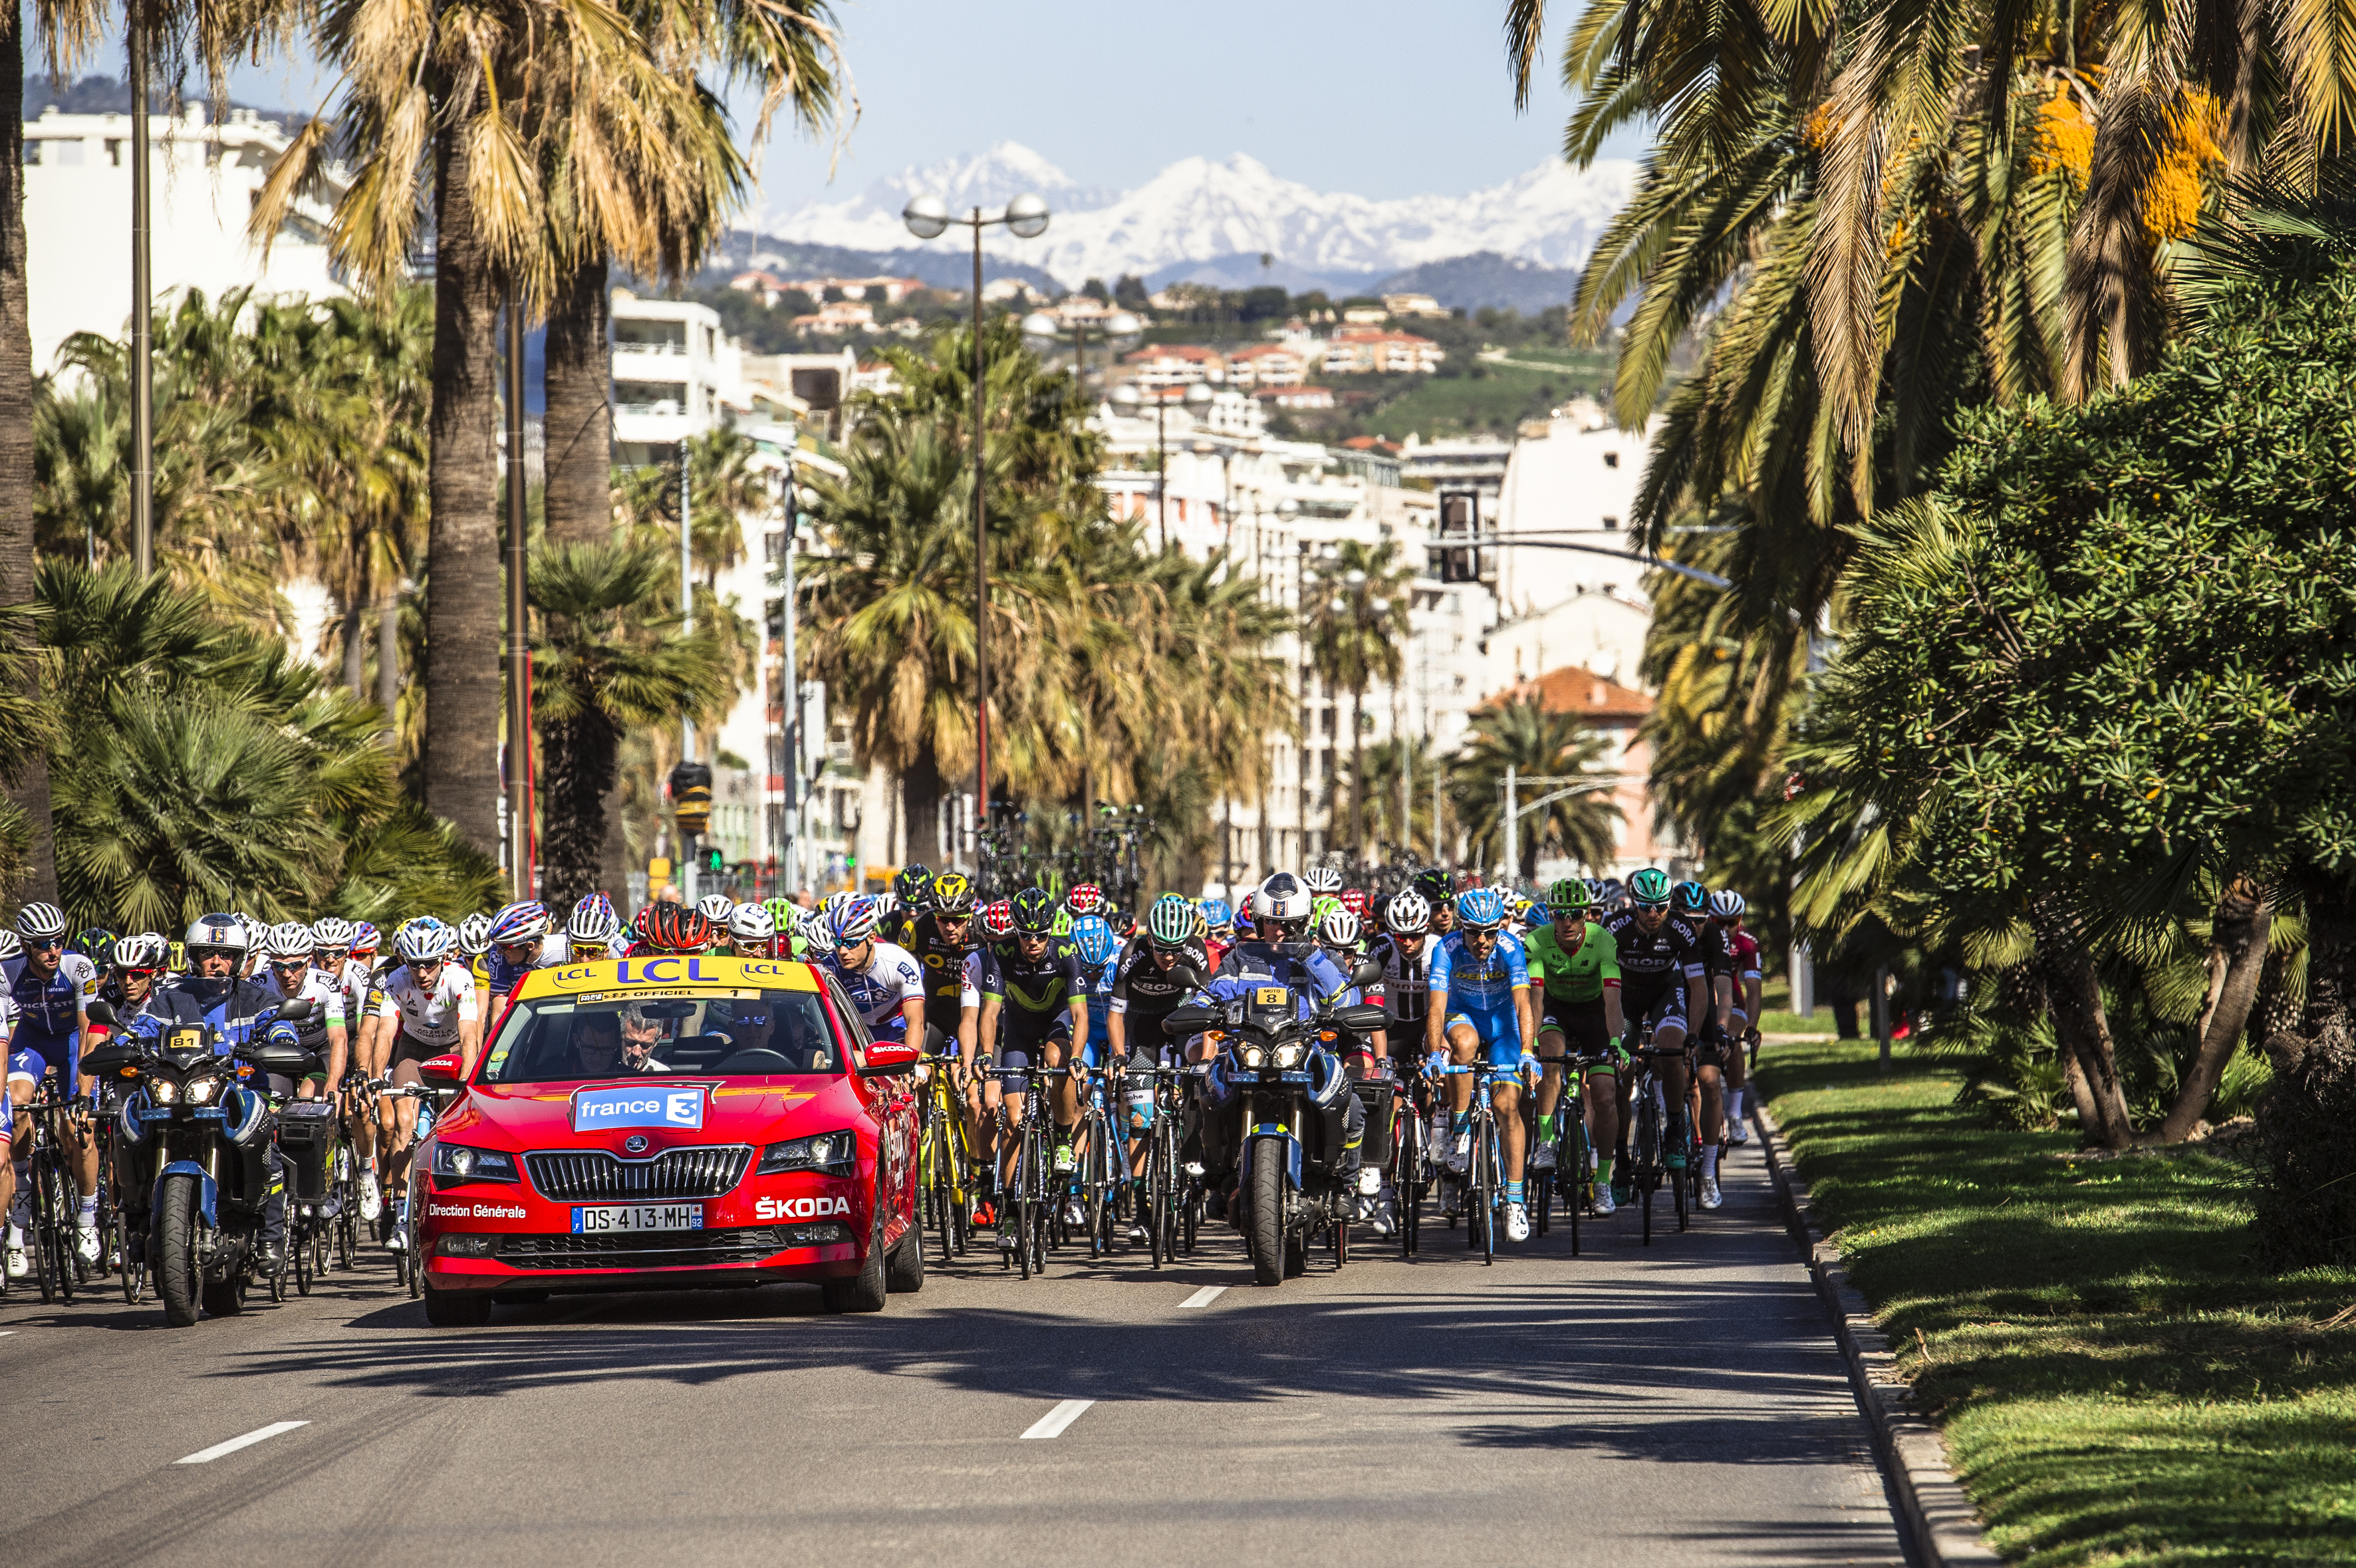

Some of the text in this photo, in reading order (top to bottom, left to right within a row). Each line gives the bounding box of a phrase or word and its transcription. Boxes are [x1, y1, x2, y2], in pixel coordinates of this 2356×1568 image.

[1672, 919, 1696, 948] BORA
[1120, 950, 1146, 974] BORA
[1187, 946, 1208, 971] BORA
[74, 966, 89, 979] PRO
[557, 968, 597, 981] LCL
[617, 958, 719, 983] LCL
[744, 963, 785, 976] LCL
[898, 964, 912, 974] FDJ
[1142, 982, 1178, 991] BOR
[1266, 994, 1277, 1003] 8
[174, 1037, 194, 1046] 81
[581, 1098, 697, 1118] france 3
[429, 1203, 527, 1220] Direction Générale
[755, 1196, 851, 1220] ŠKODA
[585, 1206, 691, 1230] DS-413-MH
[692, 1218, 702, 1228] 92
